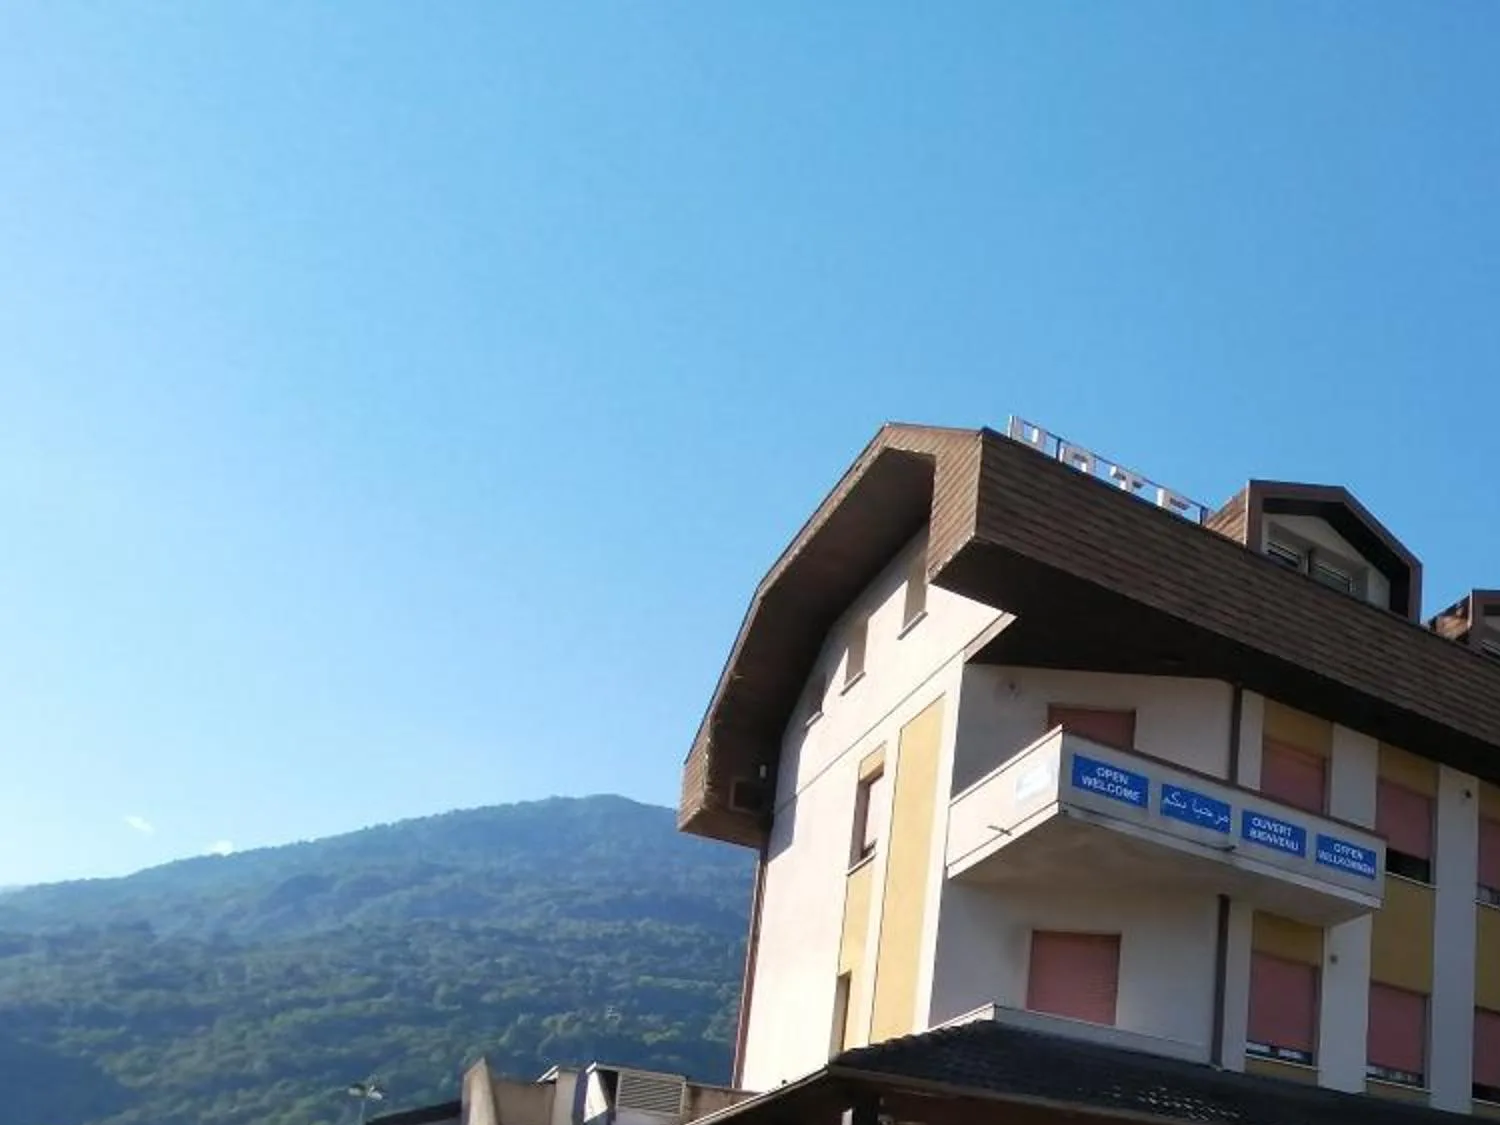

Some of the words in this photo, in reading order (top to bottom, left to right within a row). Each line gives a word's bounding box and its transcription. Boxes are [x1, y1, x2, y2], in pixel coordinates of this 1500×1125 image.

[1096, 767, 1129, 785] OPEN
[1082, 775, 1141, 803] WELCOME
[1251, 817, 1293, 837] OUVERT
